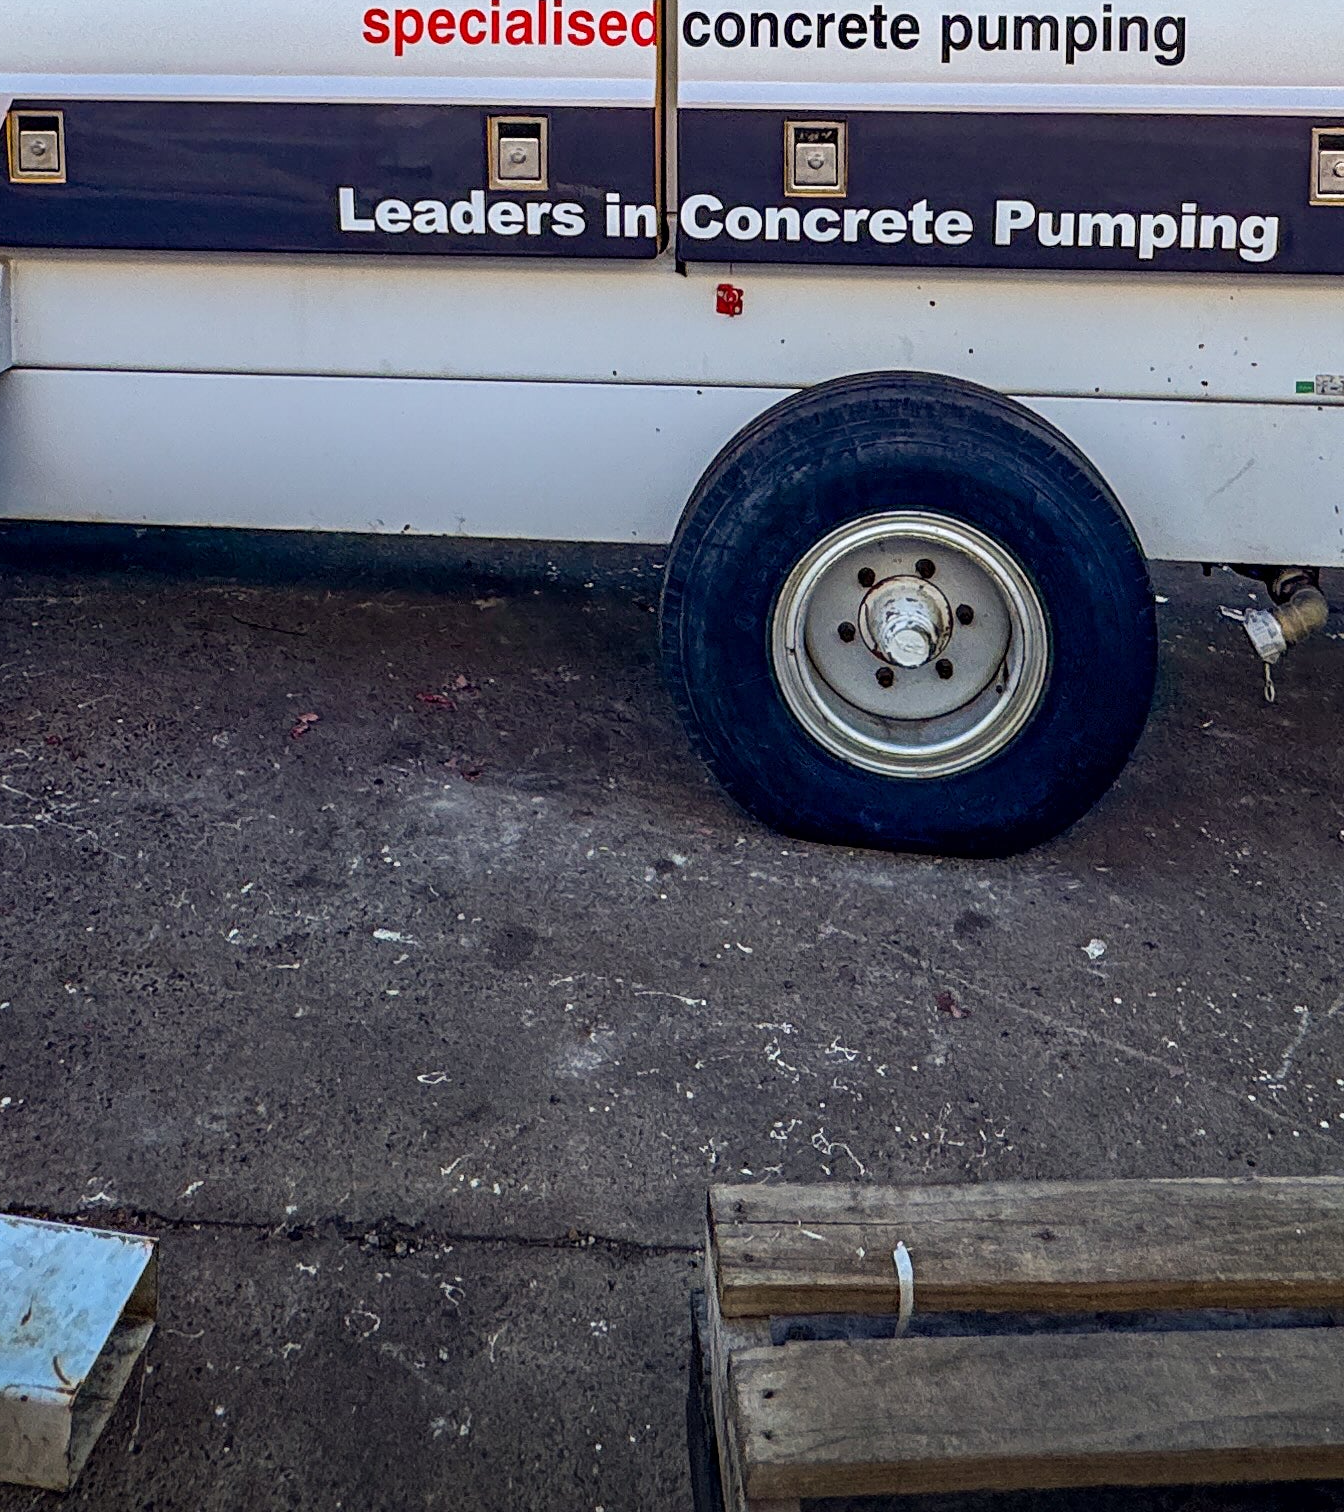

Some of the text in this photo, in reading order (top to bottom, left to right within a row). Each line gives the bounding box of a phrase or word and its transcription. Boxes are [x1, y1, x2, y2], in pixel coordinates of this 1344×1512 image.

[682, 5, 920, 50] concrete
[941, 4, 1186, 66] pumping
[338, 187, 1279, 261] Leaders in Concrete Pumping
